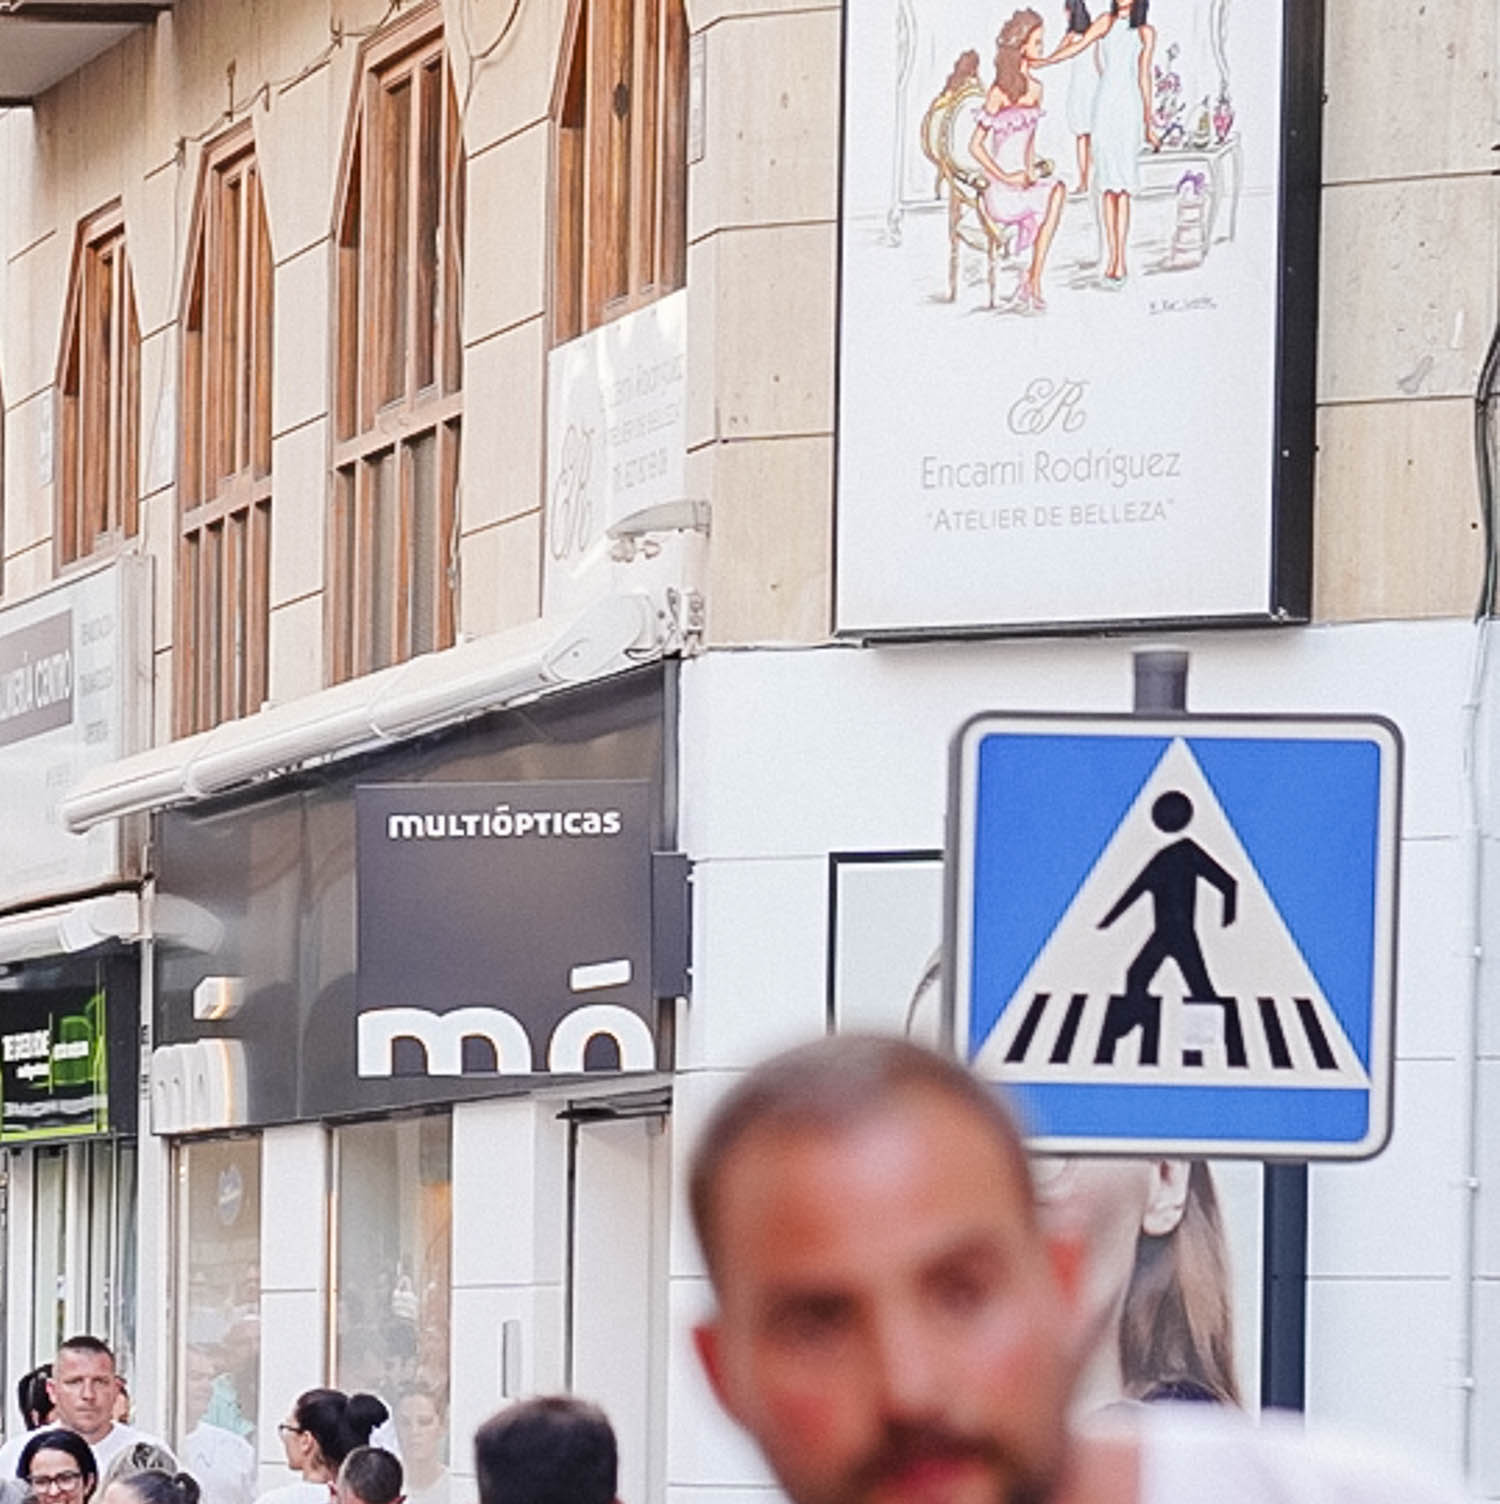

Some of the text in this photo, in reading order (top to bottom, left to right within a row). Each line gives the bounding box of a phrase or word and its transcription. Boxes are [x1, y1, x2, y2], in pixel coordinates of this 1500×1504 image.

[921, 448, 1181, 490] Encarni Rodríguez
[1034, 505, 1063, 528] DE
